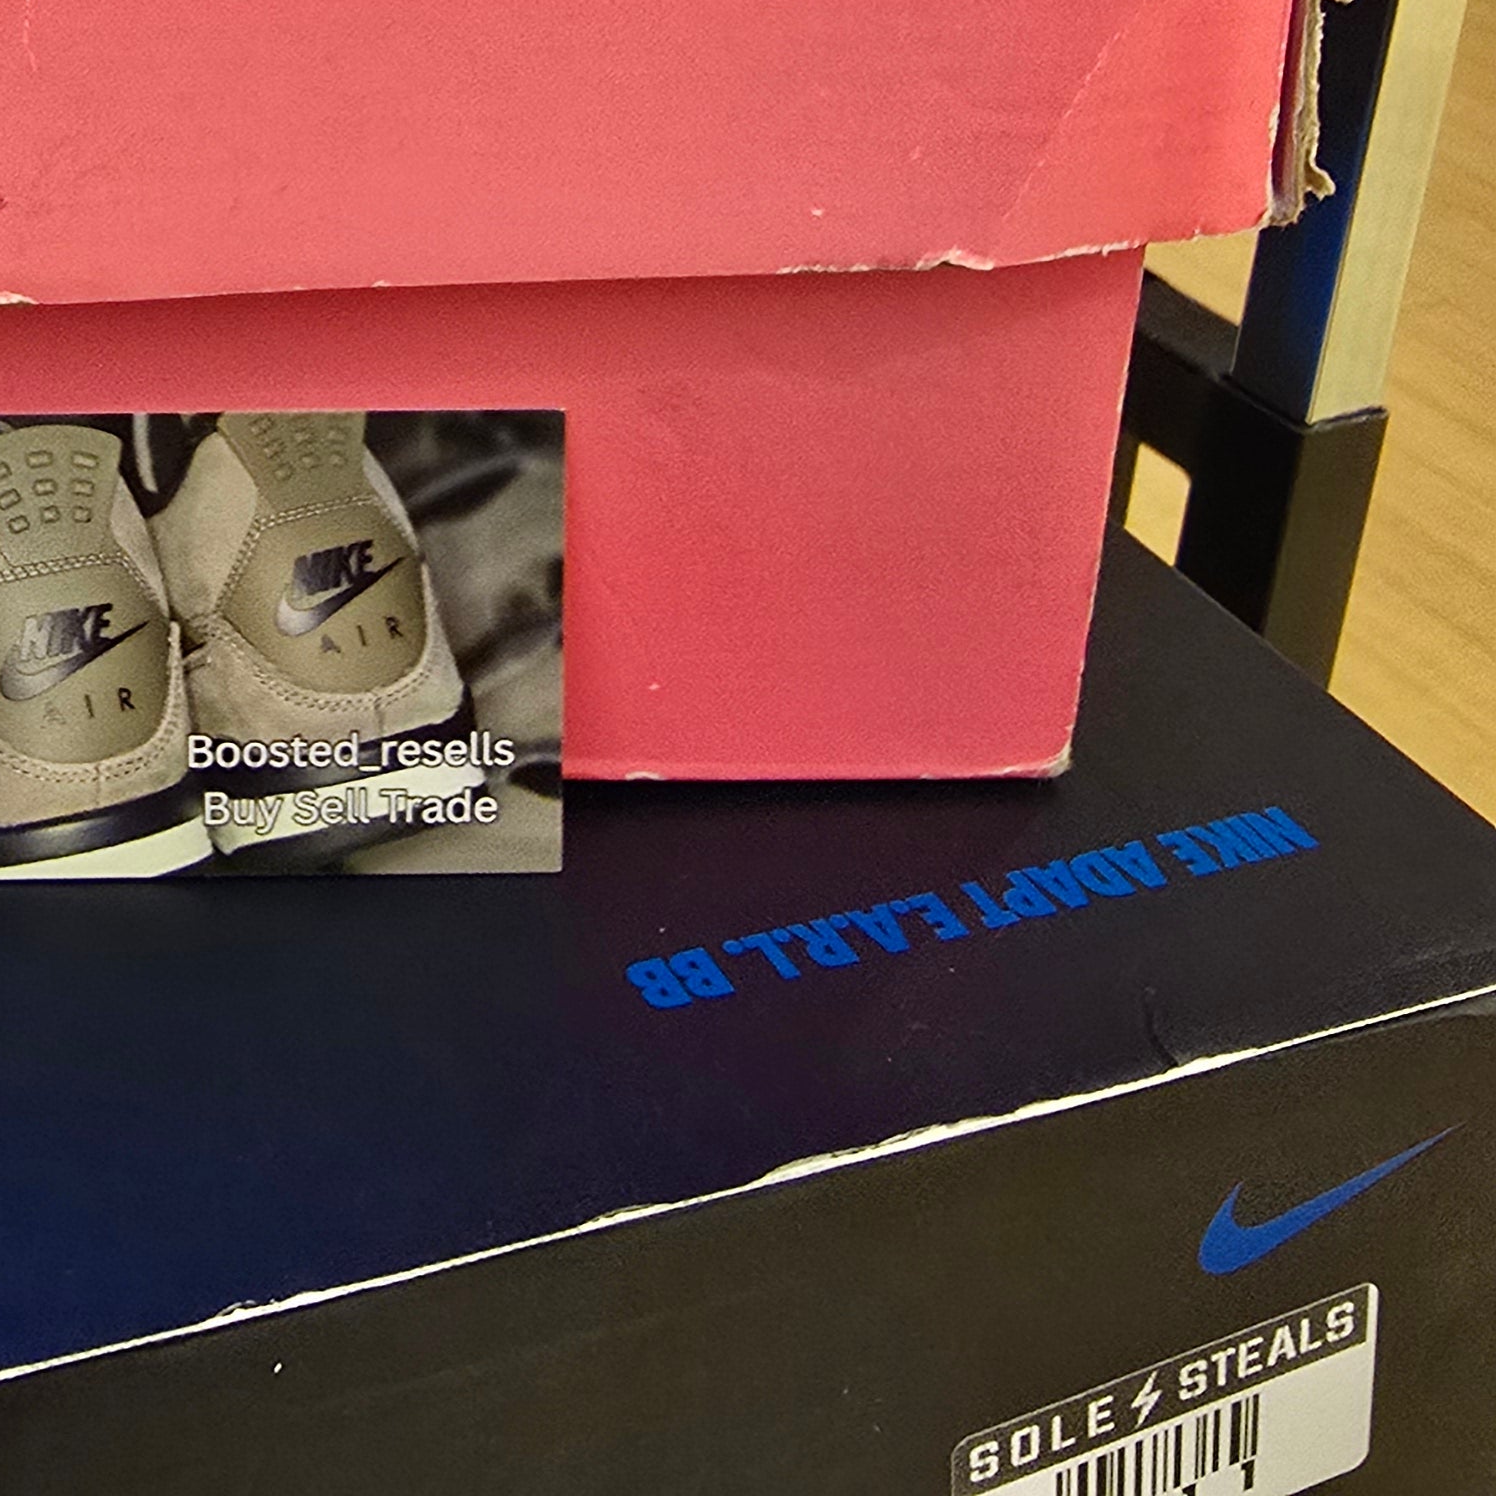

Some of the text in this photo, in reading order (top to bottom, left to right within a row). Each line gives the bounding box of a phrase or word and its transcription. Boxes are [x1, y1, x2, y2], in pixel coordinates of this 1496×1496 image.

[292, 539, 375, 600] NIKE
[19, 602, 114, 662] NIKE
[320, 616, 404, 653] AIR
[187, 731, 516, 772] Boosted_resells
[204, 787, 498, 834] Buy Sell Trade
[1156, 806, 1319, 876] NIKE
[961, 840, 1168, 929] ADAPT
[625, 947, 736, 1009] BB
[968, 1301, 1355, 1483] SOLE STEALS
